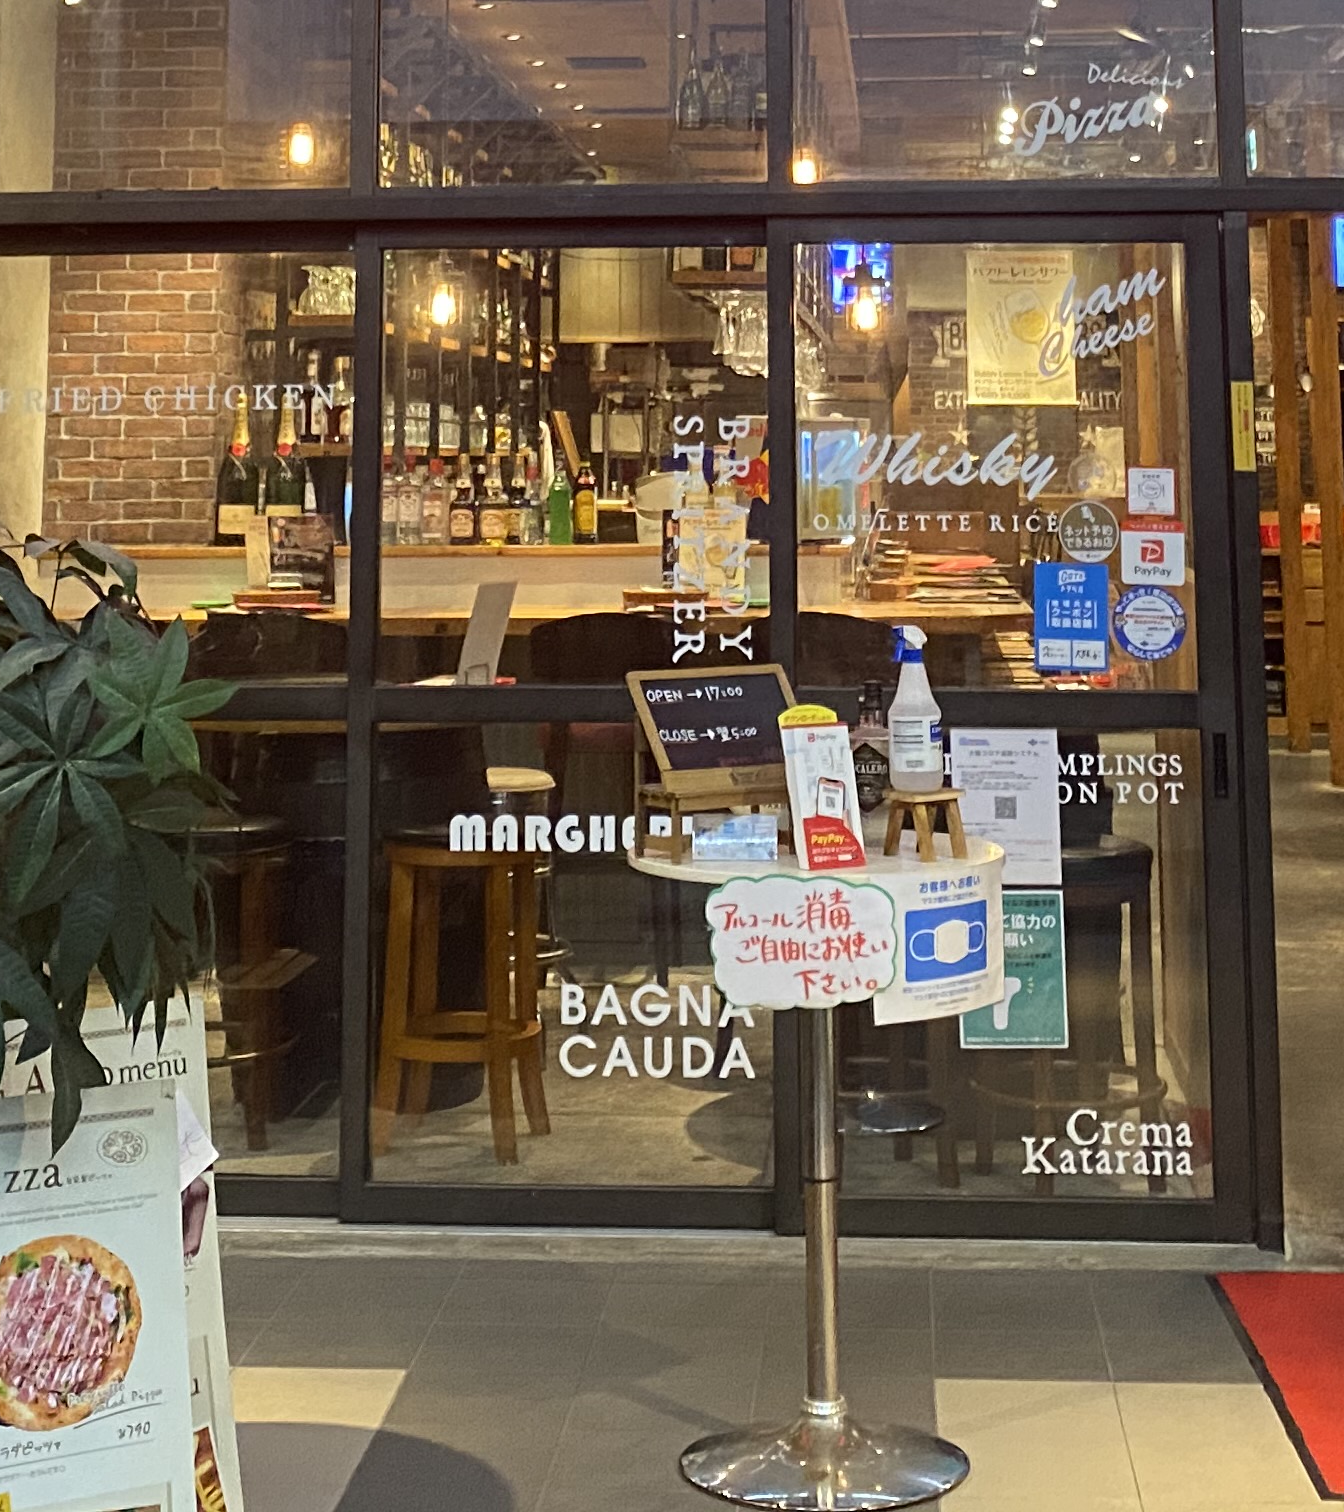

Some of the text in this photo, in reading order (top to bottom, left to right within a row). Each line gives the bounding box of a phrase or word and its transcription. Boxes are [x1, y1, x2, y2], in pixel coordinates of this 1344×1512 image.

[1087, 60, 1186, 90] Delicious
[1013, 90, 1164, 156] Pizza
[1059, 268, 1166, 327] ham
[1039, 313, 1155, 377] Cheese
[145, 384, 336, 411] CHICKEN
[814, 430, 1059, 501] Whisky
[813, 510, 1059, 533] OMELETTE RICE
[1064, 525, 1113, 537] ネット予約
[672, 415, 705, 664] SPRITZER
[1064, 537, 1113, 548] できるお店
[1134, 566, 1172, 577] PayPay
[1051, 608, 1092, 618] クーポン
[646, 686, 744, 703] OPEN 17:00
[658, 728, 698, 742] CLOSE
[1116, 781, 1186, 805] POT
[811, 834, 845, 845] PayPay
[713, 887, 857, 933] アルコール消毒
[735, 931, 888, 964] ご自由にお使い
[793, 969, 878, 1000] 下さい。
[560, 983, 755, 1028] BAGNA
[119, 1055, 188, 1082] menu
[559, 1033, 756, 1080] CAUDA
[1066, 1108, 1194, 1149] Crema
[1022, 1135, 1194, 1177] Katarana
[118, 1421, 151, 1439] ¥790
